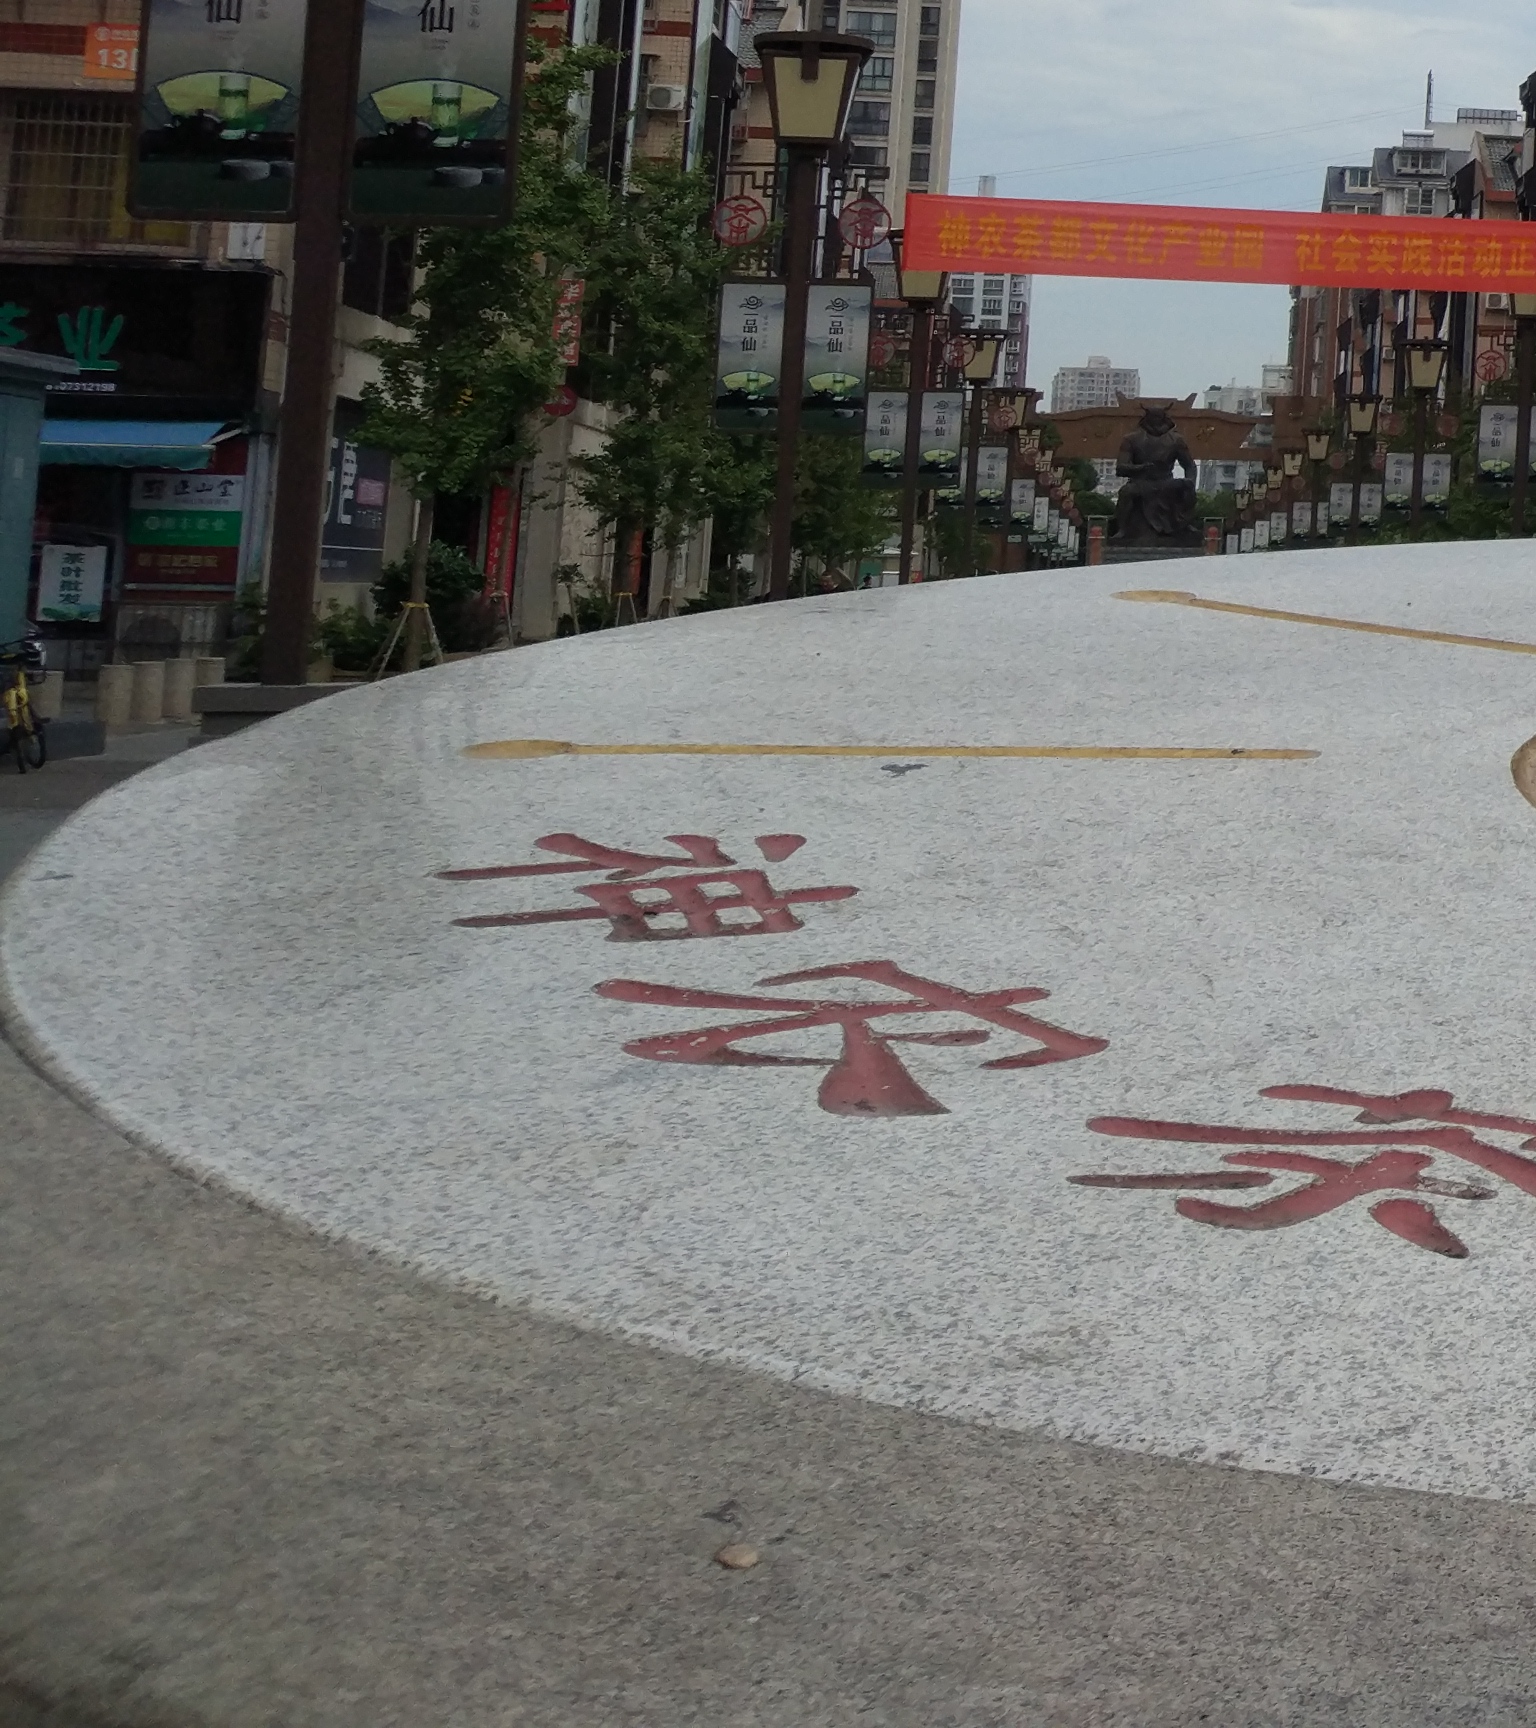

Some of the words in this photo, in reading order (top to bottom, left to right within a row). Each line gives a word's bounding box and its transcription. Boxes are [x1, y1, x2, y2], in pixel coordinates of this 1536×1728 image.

[97, 47, 138, 70] 13
[938, 210, 1265, 268] 神农茶都文化产业园
